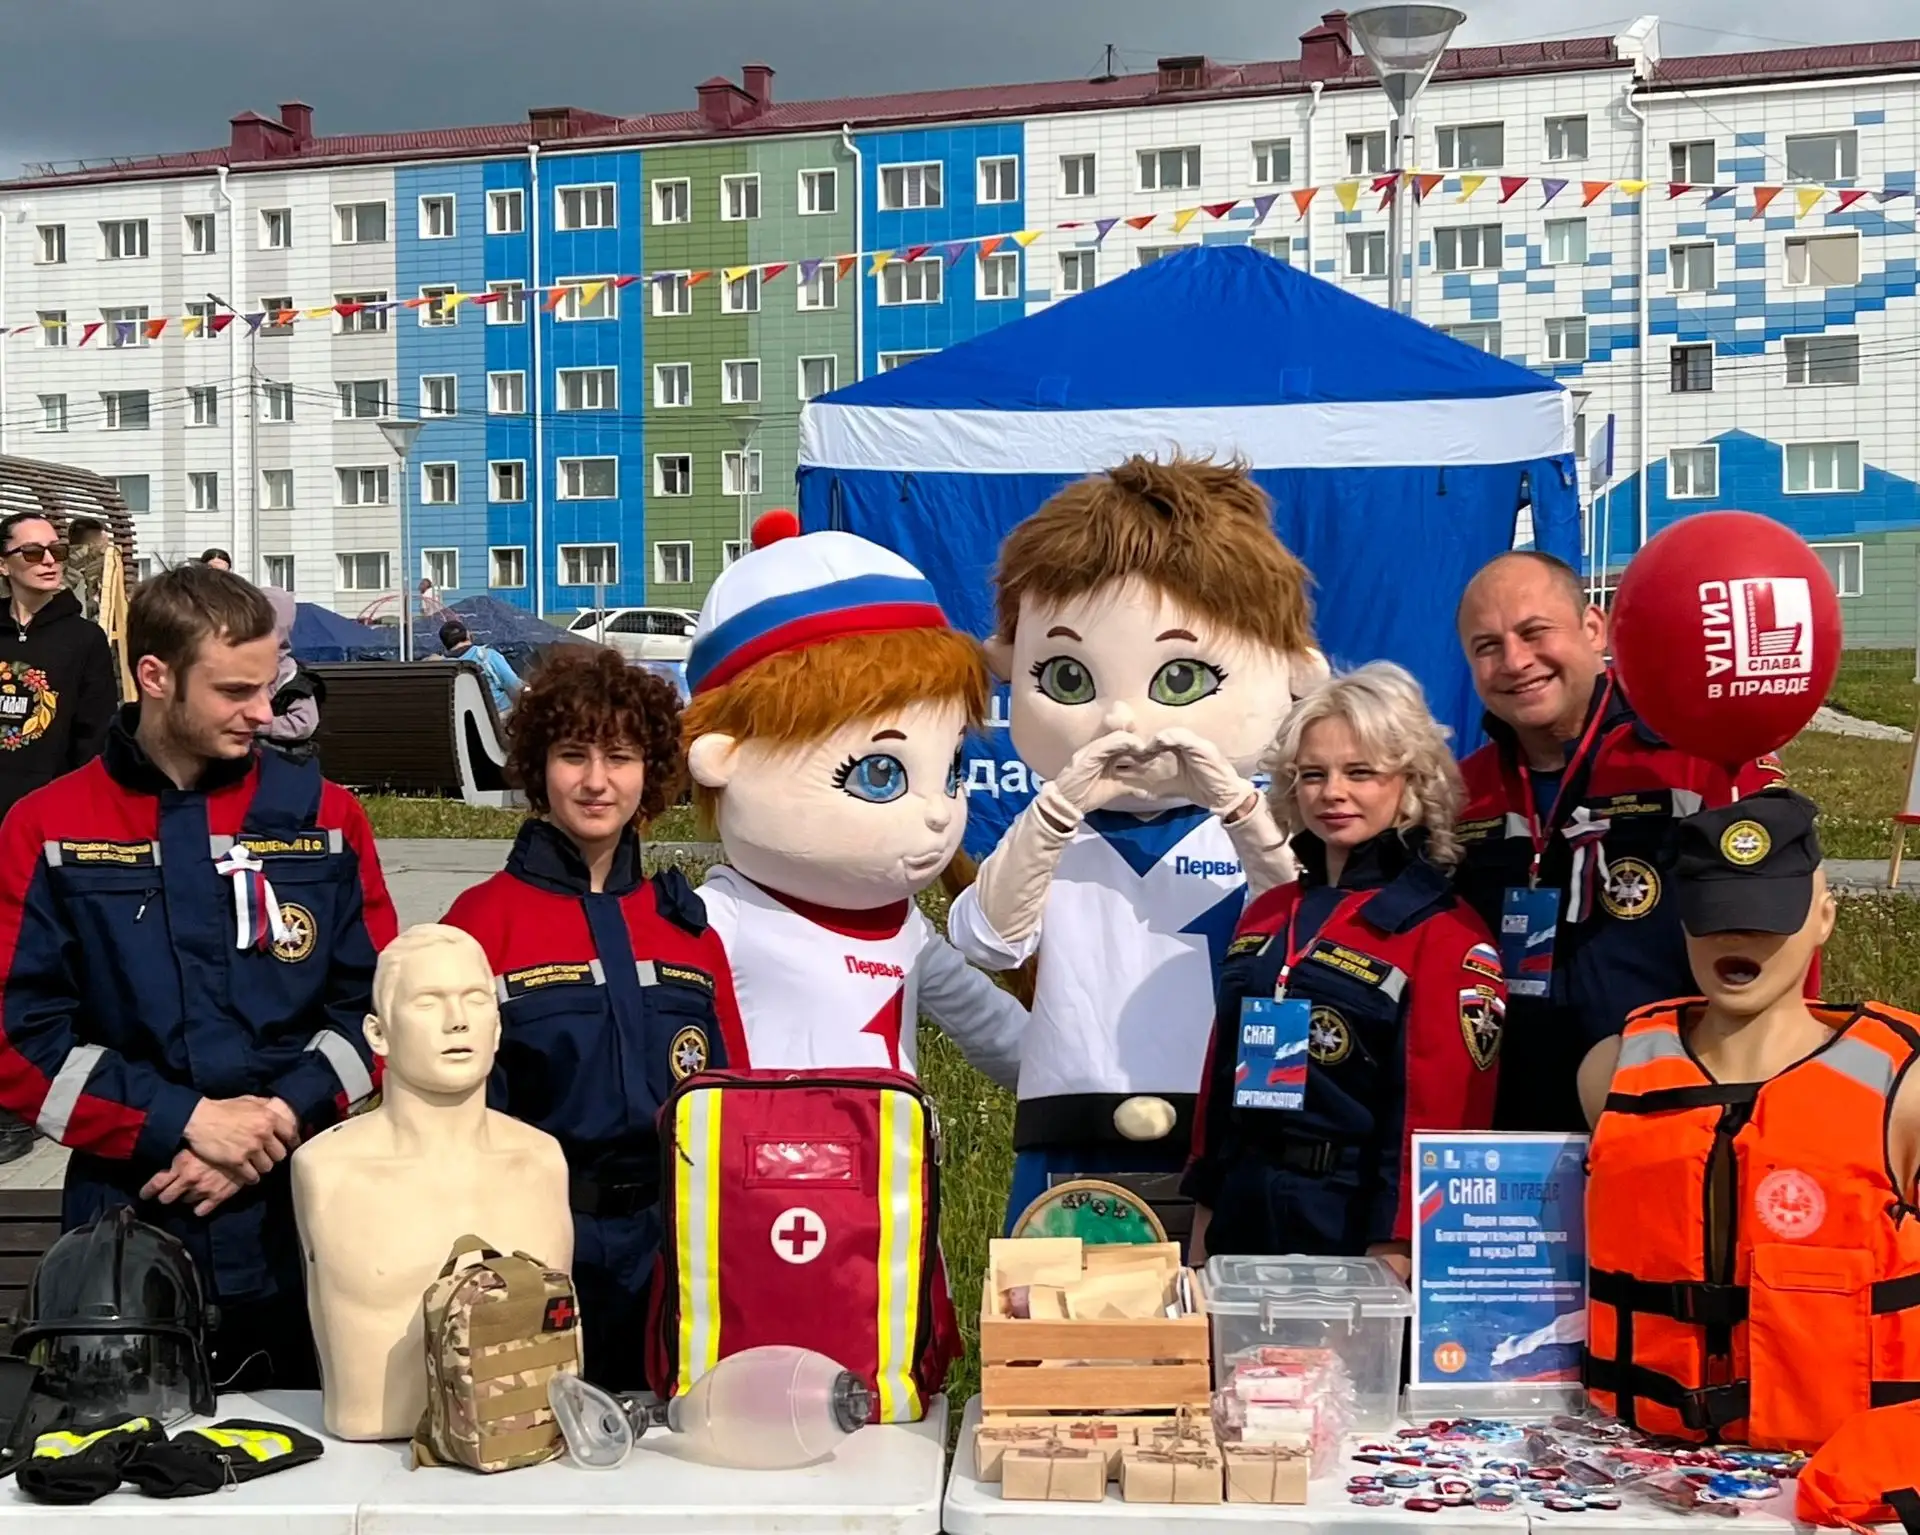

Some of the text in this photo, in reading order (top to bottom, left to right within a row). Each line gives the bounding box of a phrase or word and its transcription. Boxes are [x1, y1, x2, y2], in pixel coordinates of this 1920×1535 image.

[1698, 581, 1733, 678] СИЛА
[1748, 658, 1802, 671] СЛАВА
[1707, 676, 1811, 699] В ПРАВДЕ
[1175, 855, 1243, 880] Первы
[844, 955, 905, 980] Первые
[1449, 1178, 1497, 1205] СИЛА
